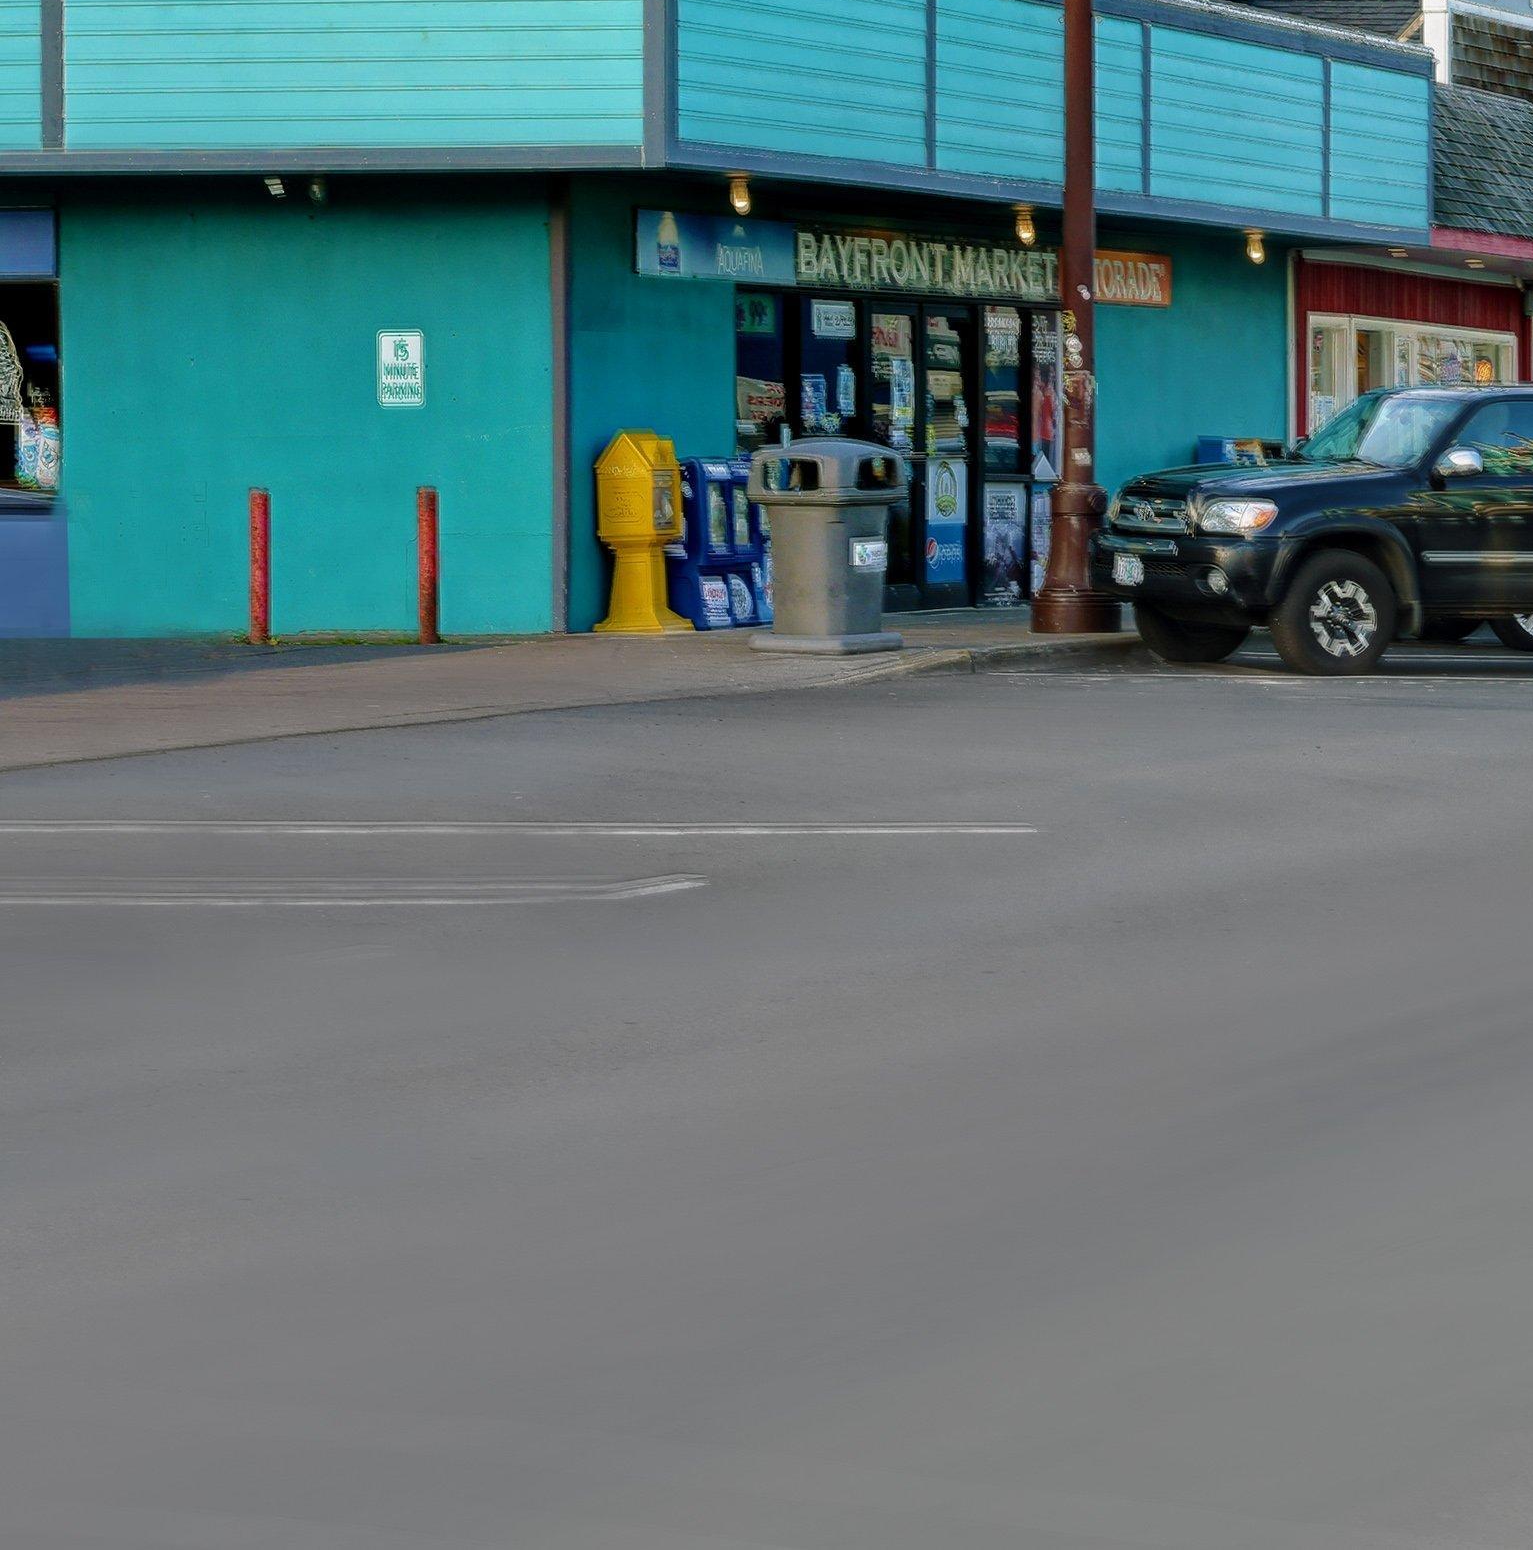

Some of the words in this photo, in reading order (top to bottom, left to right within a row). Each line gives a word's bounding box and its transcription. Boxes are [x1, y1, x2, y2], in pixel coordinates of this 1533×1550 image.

[717, 245, 764, 275] AQUAFINA
[798, 232, 950, 286] BAYFRONT
[951, 246, 1059, 297] MARKET
[1092, 257, 1162, 301] TORADE
[393, 338, 410, 361] 15
[383, 362, 420, 380] MINUTE
[381, 382, 422, 400] PARKING
